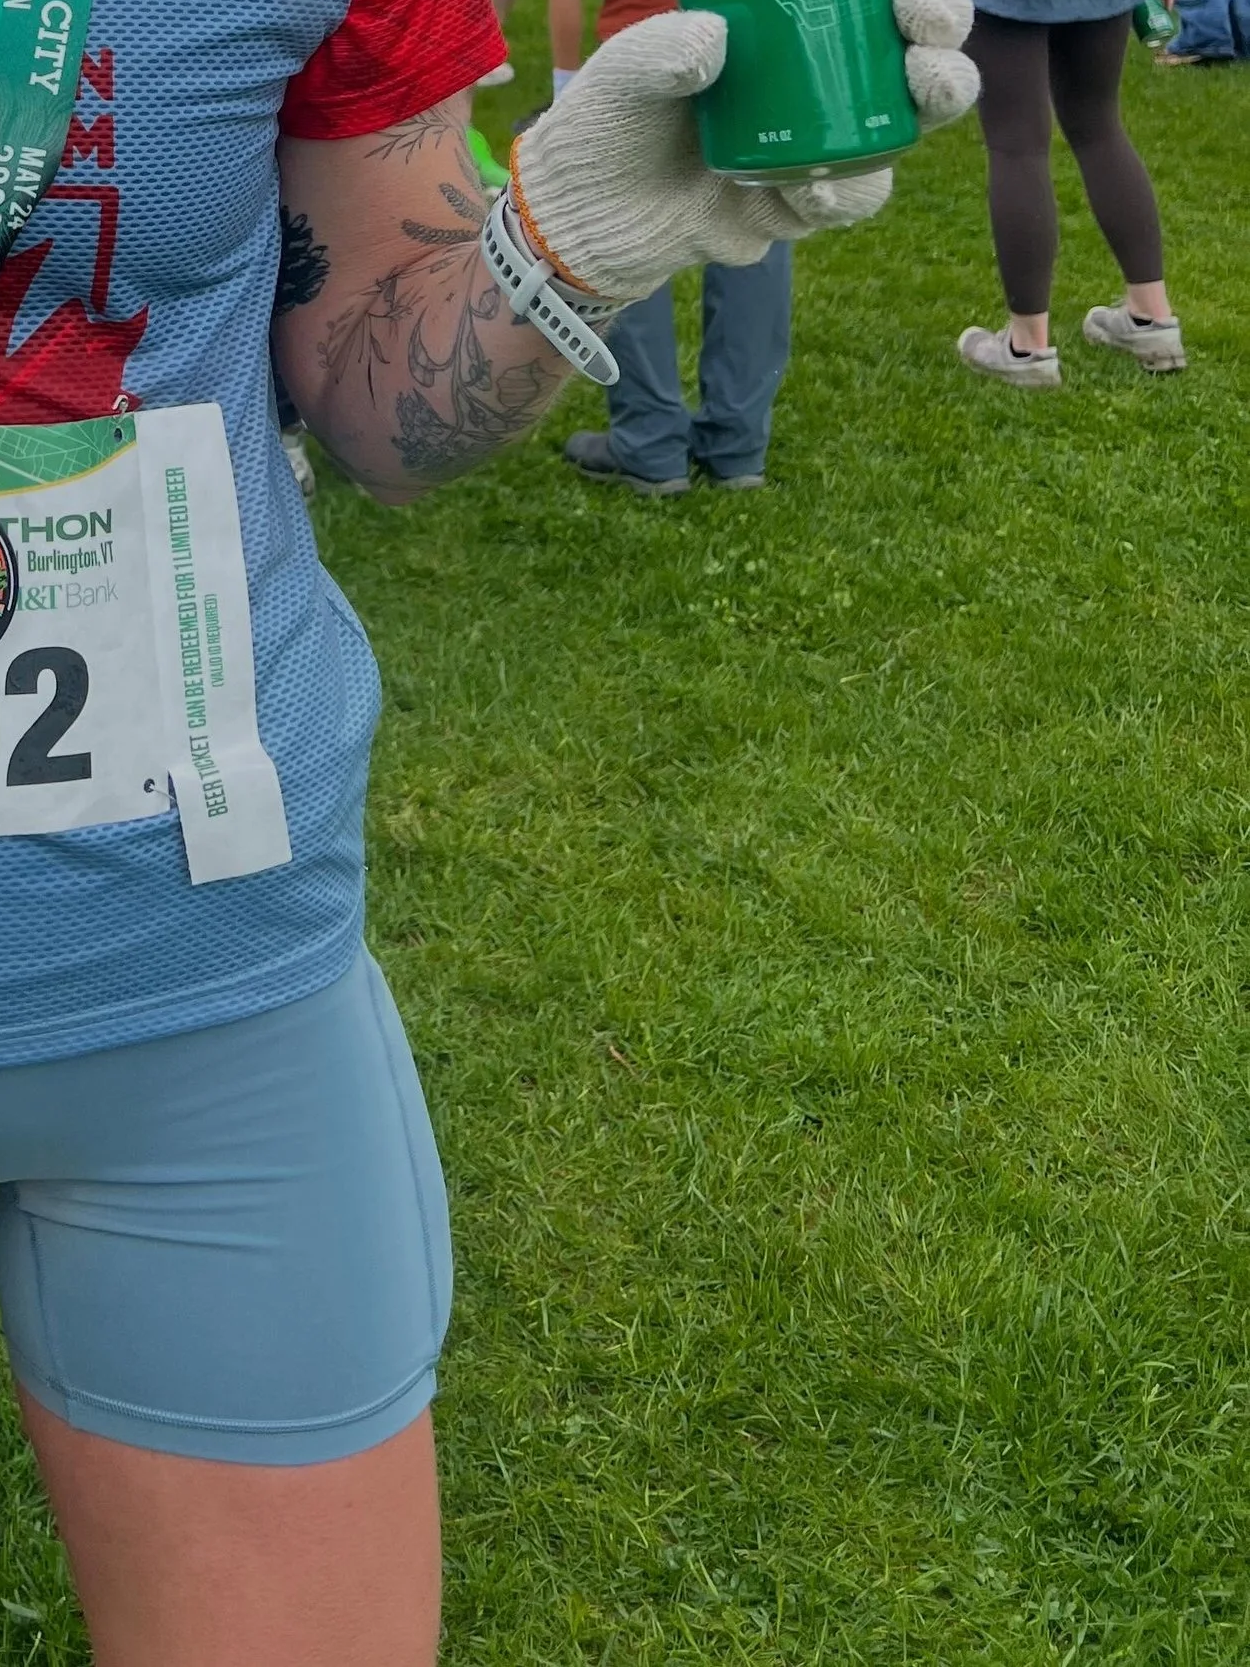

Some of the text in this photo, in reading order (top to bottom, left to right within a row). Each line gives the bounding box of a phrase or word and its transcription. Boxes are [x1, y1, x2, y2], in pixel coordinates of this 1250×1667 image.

[29, 0, 73, 96] CITY
[7, 146, 47, 230] MAY 24
[65, 575, 119, 609] Bank
[165, 466, 229, 818] BEER TICKET CAN BE REDEEMED FOR 1 LIMITED BEER
